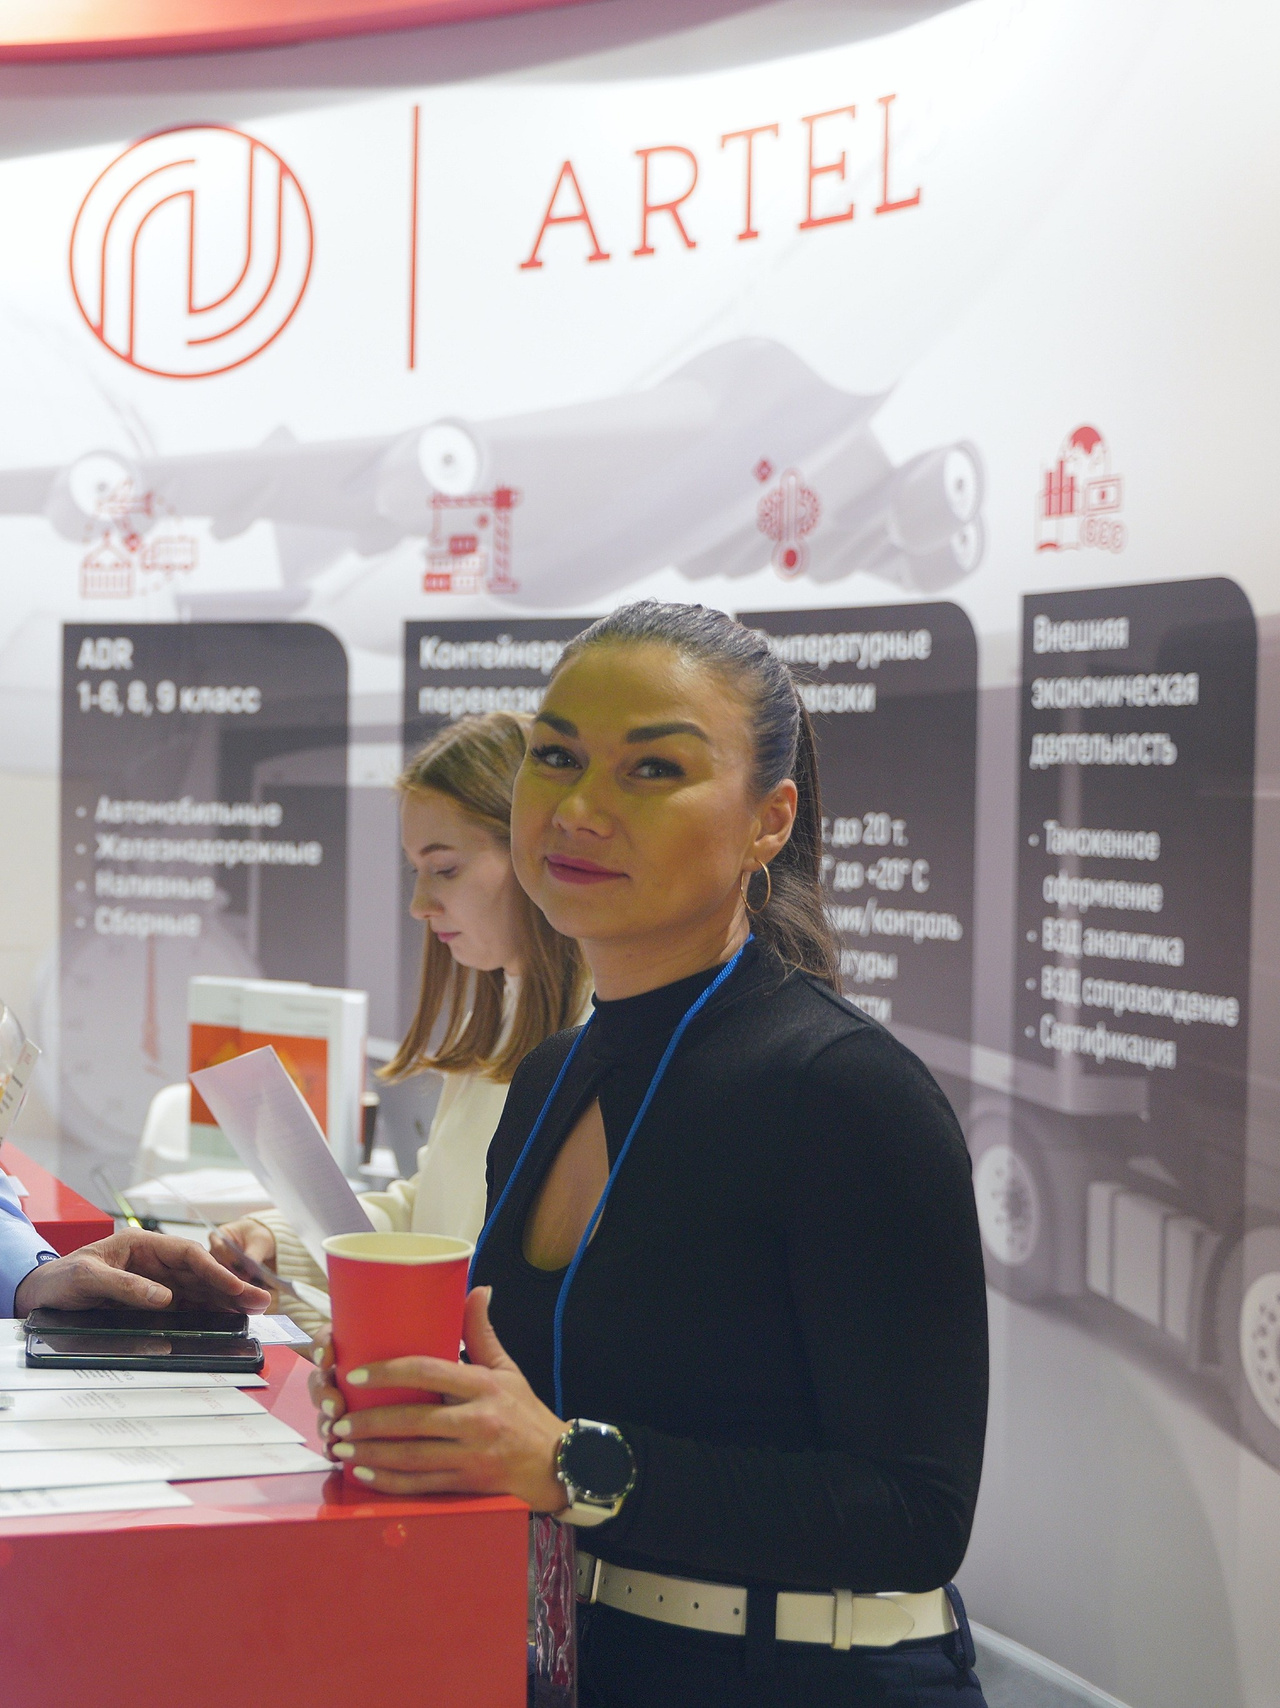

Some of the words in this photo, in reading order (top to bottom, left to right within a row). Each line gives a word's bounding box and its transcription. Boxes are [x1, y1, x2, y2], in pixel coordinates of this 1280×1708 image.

[520, 93, 923, 270] ARTEL
[76, 637, 135, 670] ADR
[768, 628, 933, 671] мпературные
[1033, 614, 1130, 654] Внешняя
[76, 680, 124, 717] 1-6,
[156, 680, 178, 714] 9
[179, 686, 263, 714] класс
[1031, 672, 1200, 710] экономическая
[1030, 732, 1178, 769] деятельность
[94, 796, 283, 828] Автомобильные
[832, 816, 863, 848] до
[863, 811, 892, 846] 20
[95, 833, 323, 868] Железнодорожные
[1044, 820, 1162, 862] Таможенное
[833, 860, 865, 892] до
[1043, 870, 1164, 912] оформление
[1083, 927, 1185, 967] аналитика
[1082, 977, 1240, 1027] сопровождение
[1039, 1013, 1177, 1069] Сертификация
